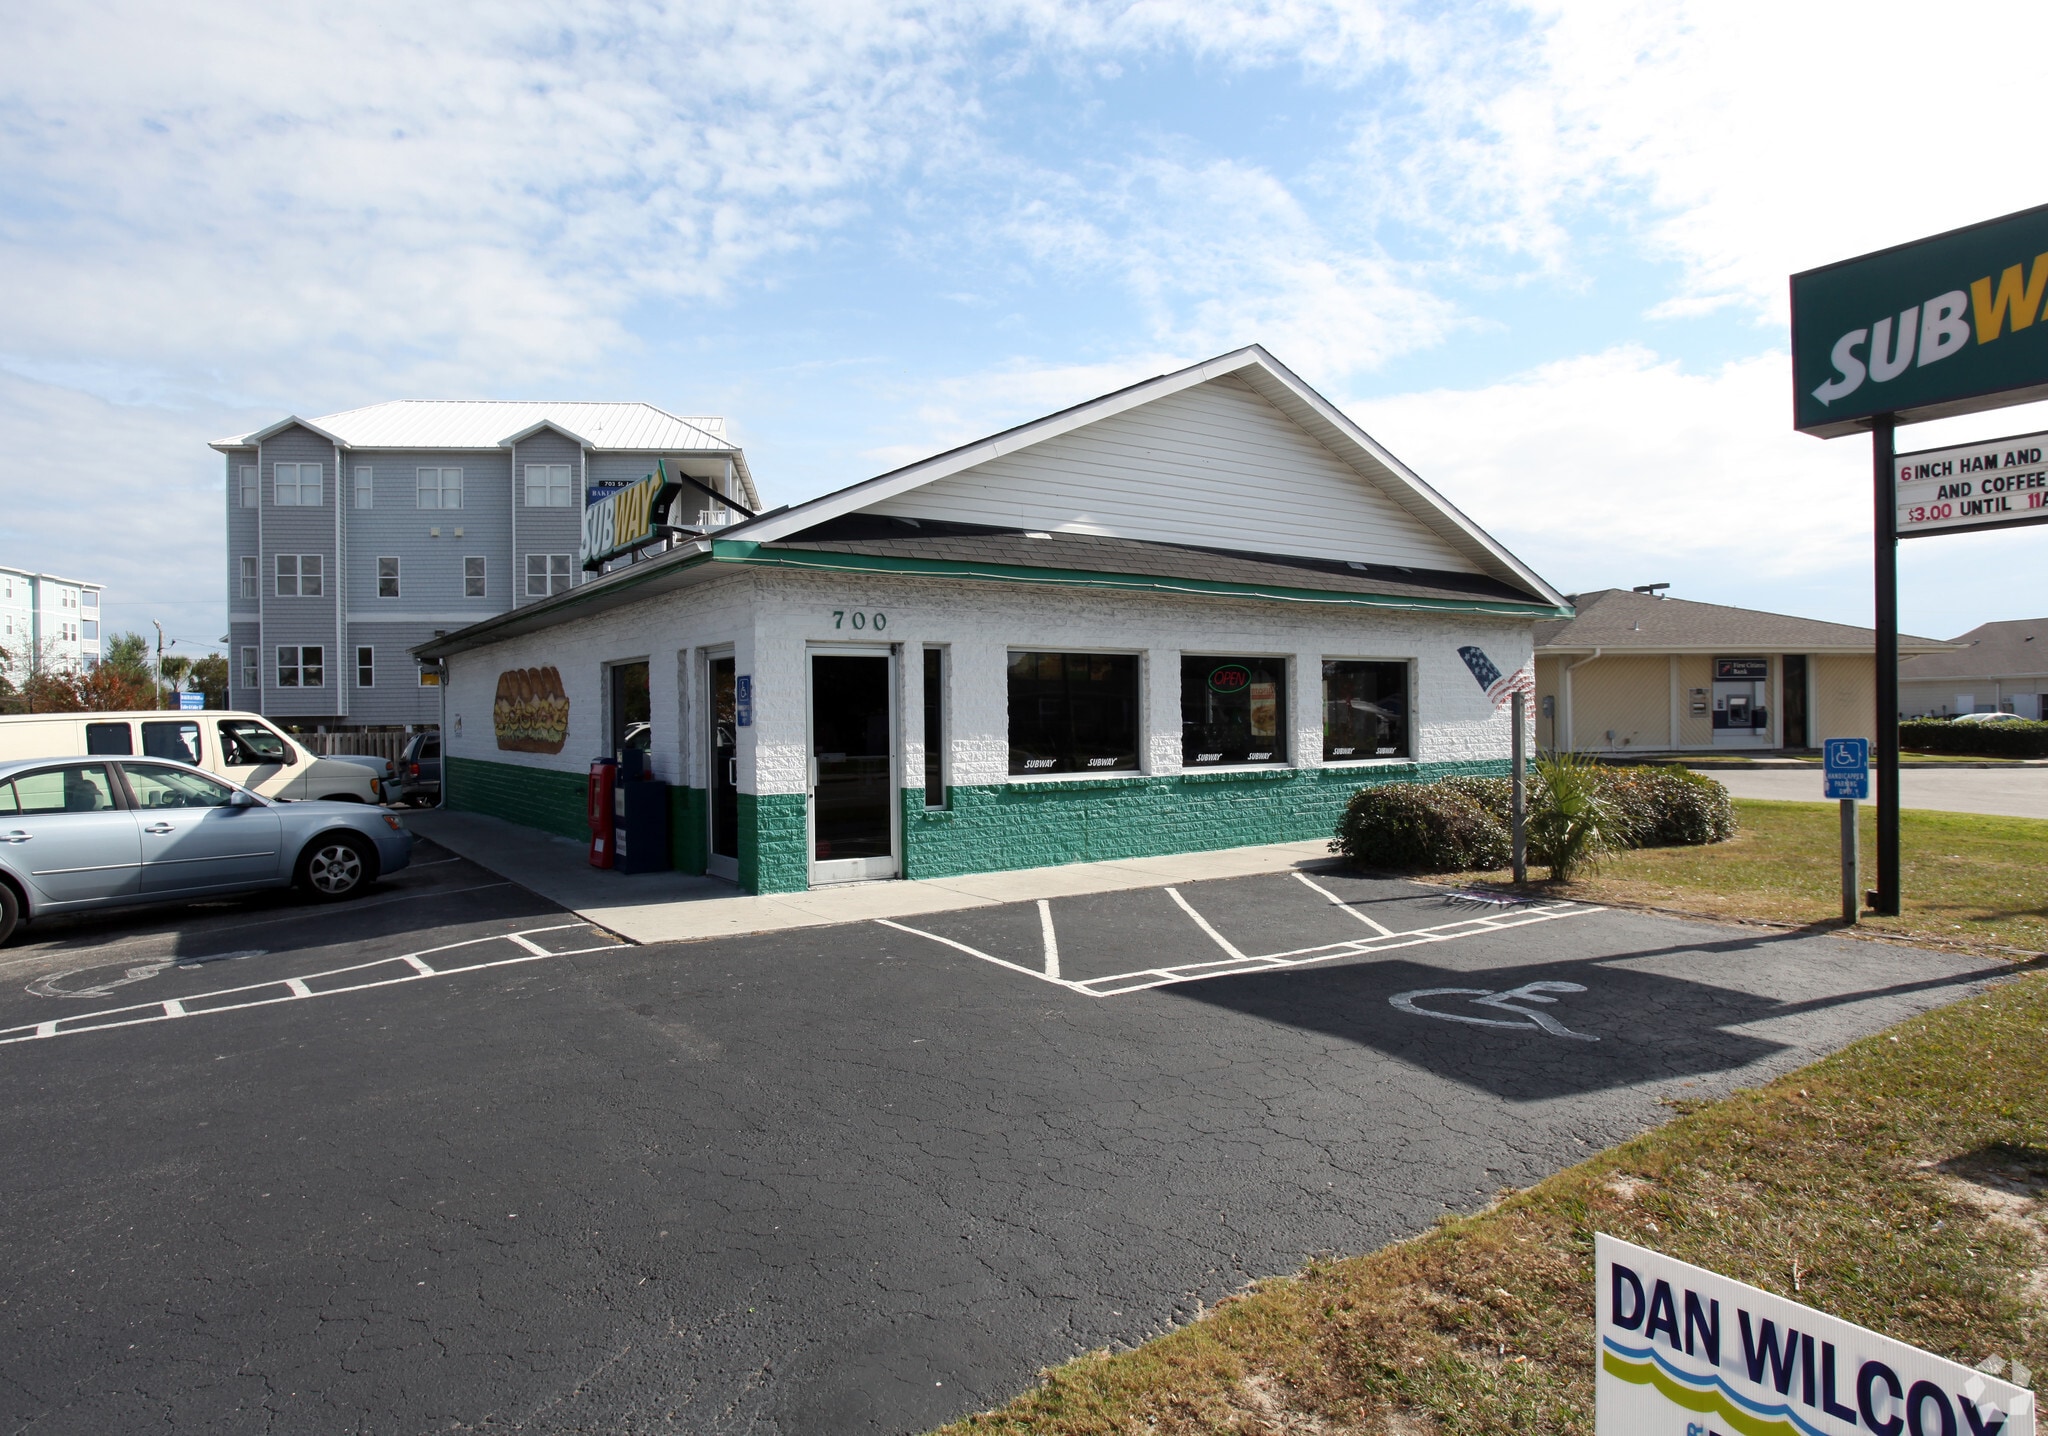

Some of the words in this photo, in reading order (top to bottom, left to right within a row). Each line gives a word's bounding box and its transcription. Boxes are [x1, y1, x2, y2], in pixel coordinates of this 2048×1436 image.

[1811, 252, 2048, 407] SUBW
[1914, 461, 1952, 479] INCH
[1960, 454, 1998, 473] HAM
[2003, 448, 2042, 467] AND
[1937, 482, 1972, 500] AND
[1981, 472, 2046, 494] COFFEE
[579, 469, 663, 561] SUBWAY
[1908, 503, 1952, 523] $3.00
[1960, 496, 2012, 516] UNTIL
[832, 610, 887, 631] 700
[1214, 670, 1247, 686] OPEN
[1196, 753, 1223, 762] SUBWAY
[1247, 752, 1272, 760] SUBWAY
[1332, 747, 1355, 755] SUBWAY
[1375, 747, 1397, 755] SUBWAY
[1024, 758, 1057, 769] SUBWAY
[1087, 757, 1118, 767] SUBWAY
[1611, 1262, 1721, 1367] DAN
